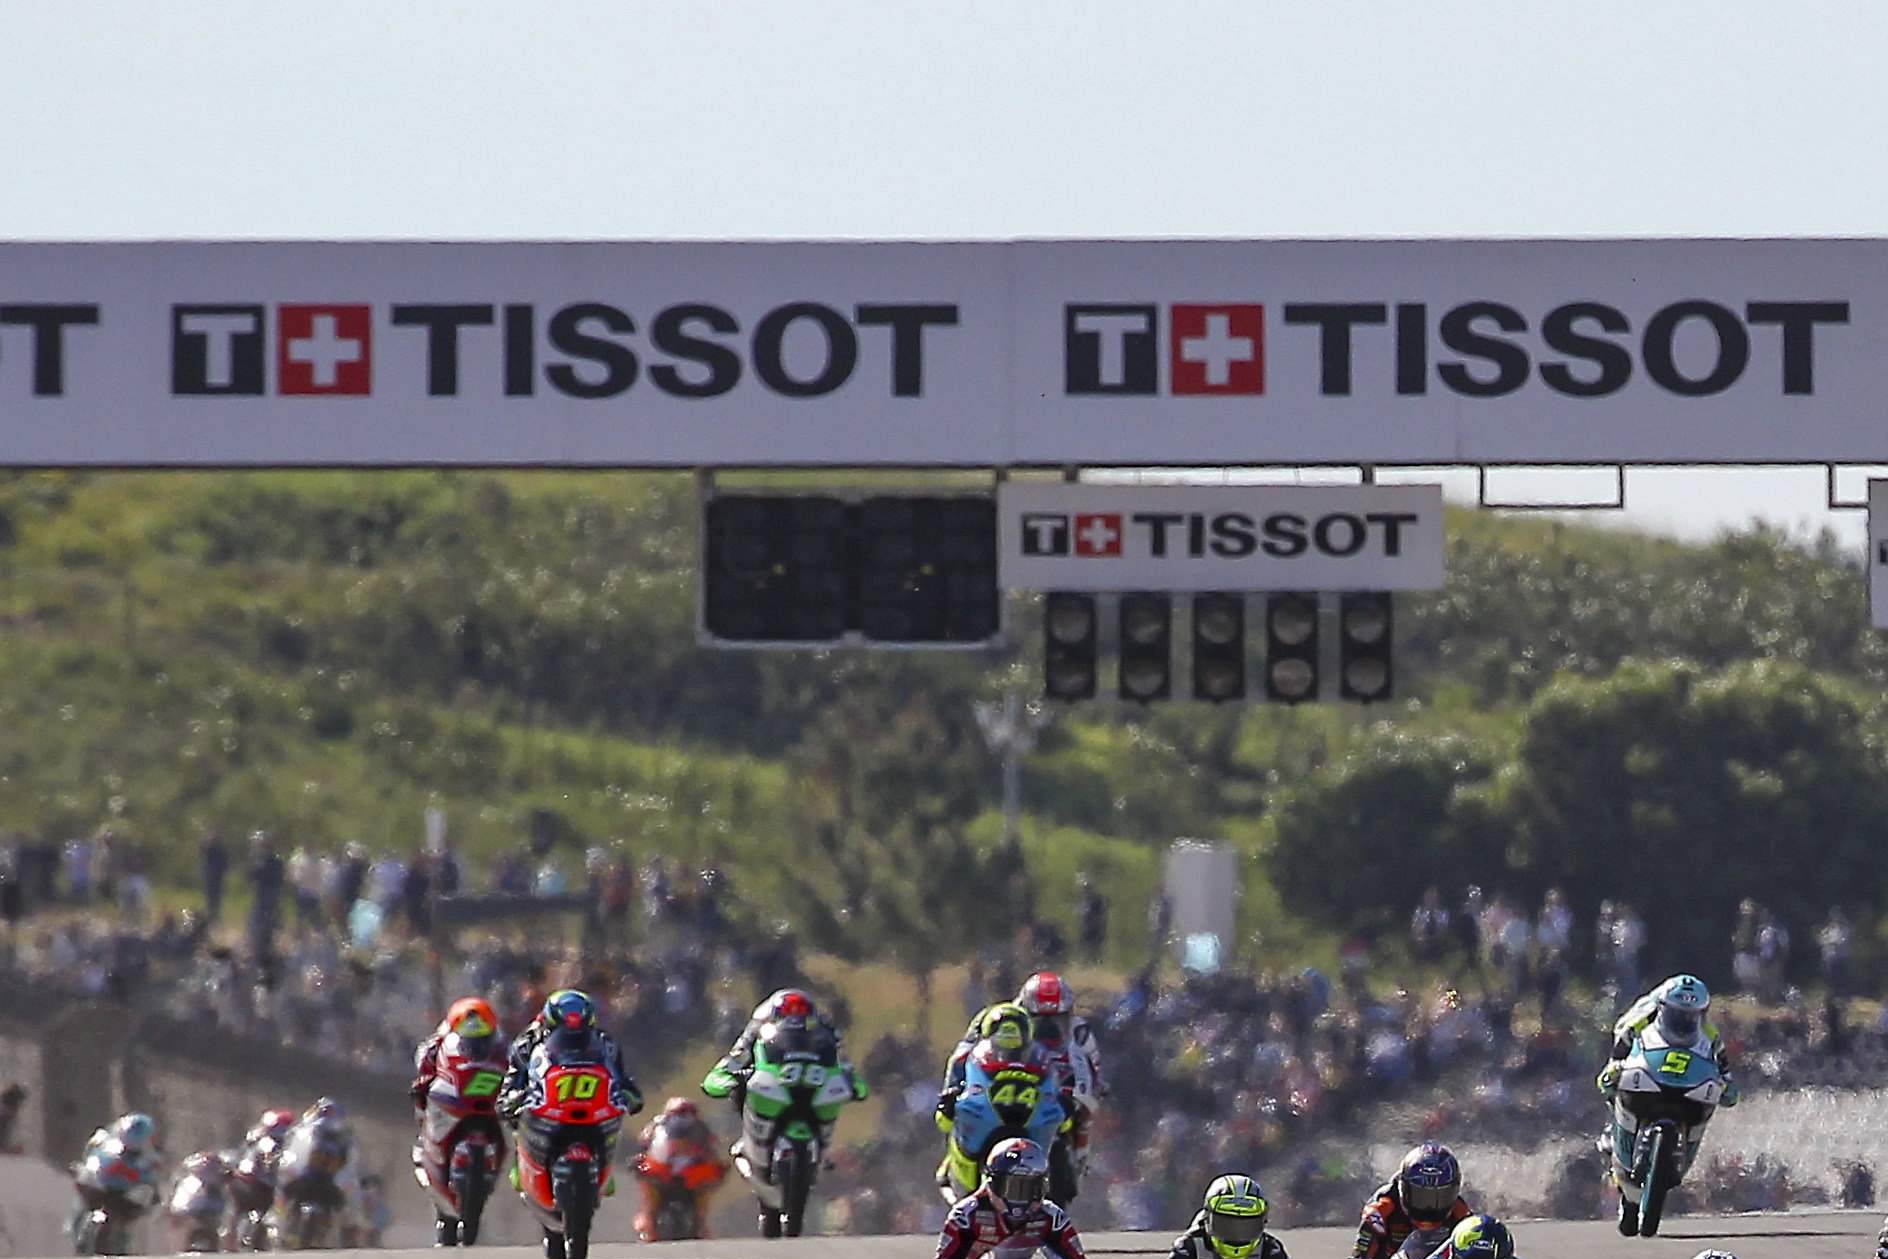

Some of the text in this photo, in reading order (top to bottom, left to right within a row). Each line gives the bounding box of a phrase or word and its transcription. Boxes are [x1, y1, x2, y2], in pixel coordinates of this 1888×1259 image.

[390, 301, 959, 399] TISSOT
[1283, 300, 1850, 398] TISSOT
[1132, 511, 1418, 559] TISSOT
[1660, 1051, 1692, 1075] 5
[555, 1073, 600, 1102] 10
[992, 1083, 1038, 1108] 44
